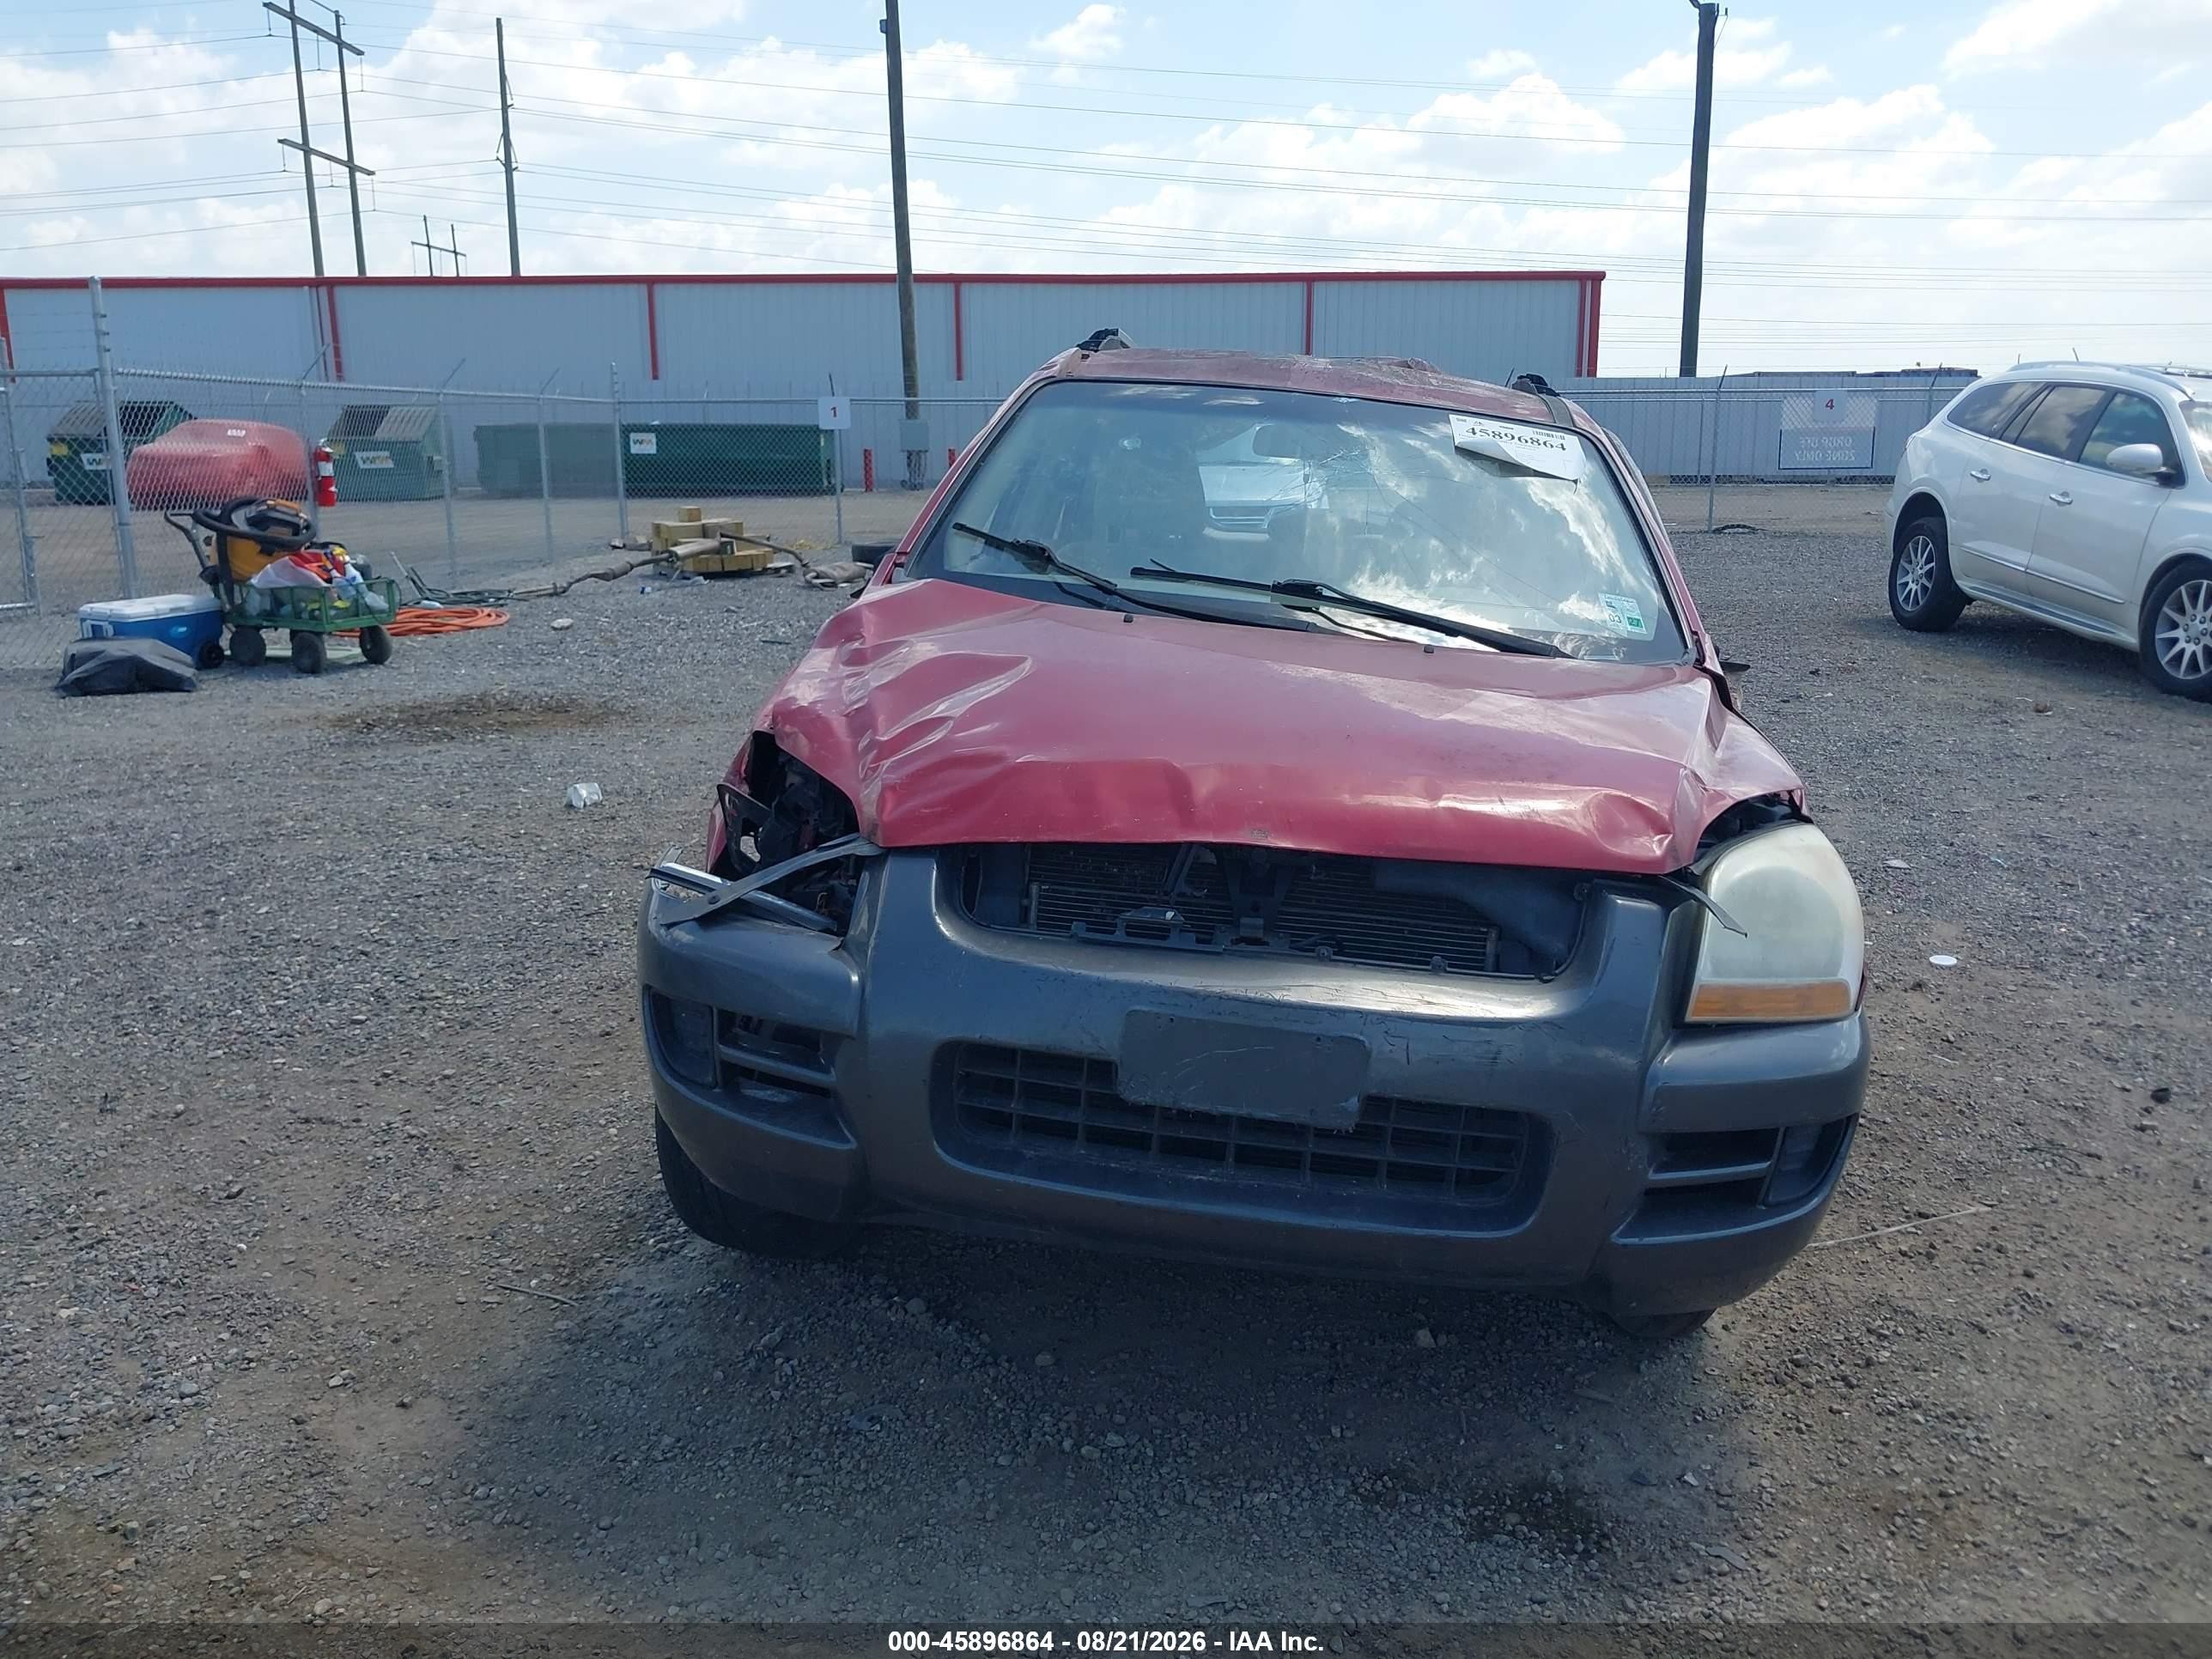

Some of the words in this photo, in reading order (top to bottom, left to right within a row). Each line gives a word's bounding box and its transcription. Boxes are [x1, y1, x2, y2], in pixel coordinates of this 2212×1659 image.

[1825, 398, 1835, 410] 4
[830, 406, 837, 418] 1
[1466, 427, 1566, 451] 45896864
